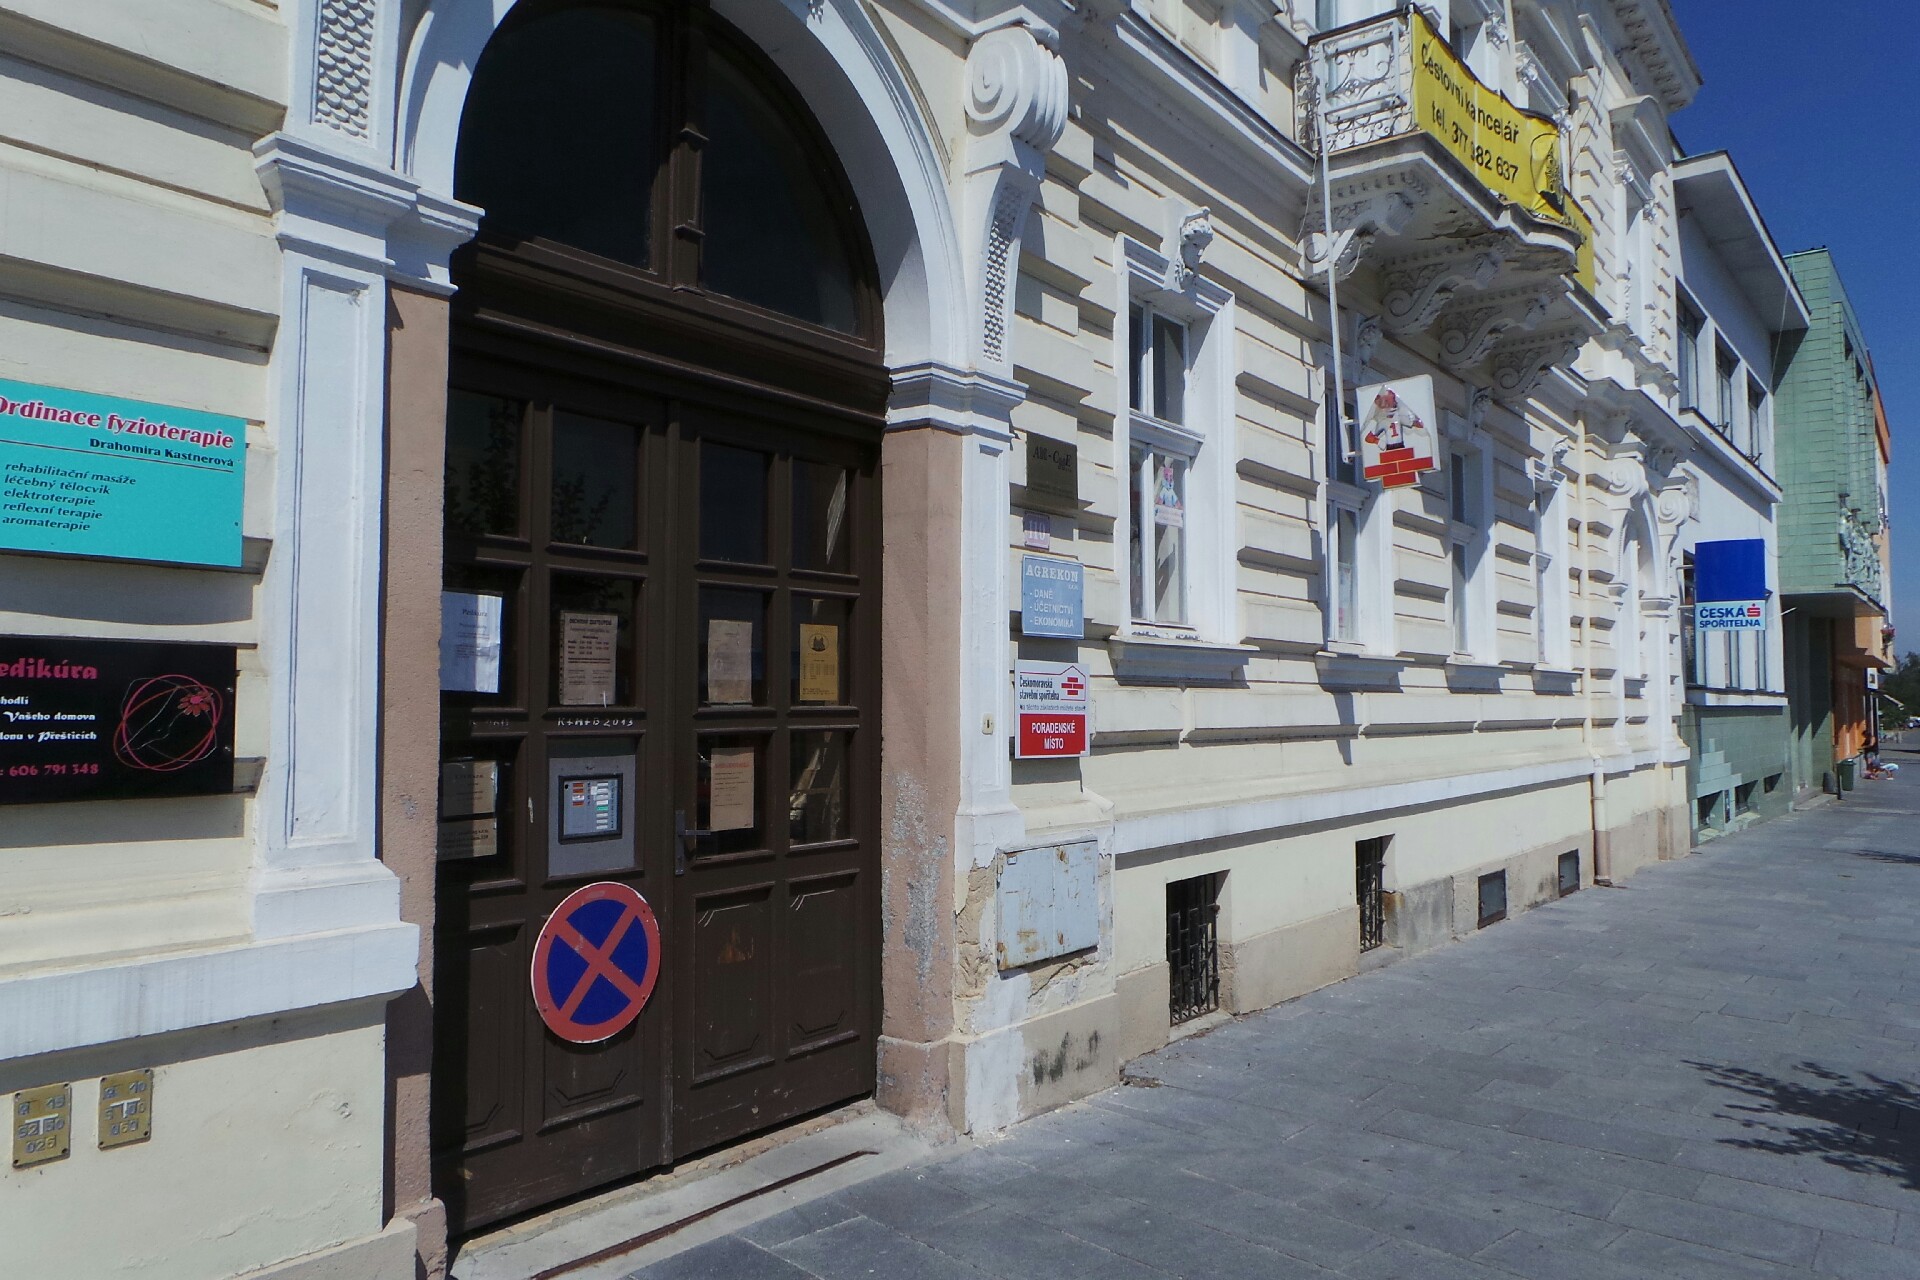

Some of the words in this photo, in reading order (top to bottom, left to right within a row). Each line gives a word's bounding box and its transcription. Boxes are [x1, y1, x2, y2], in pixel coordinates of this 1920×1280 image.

[1465, 91, 1519, 144] kancelář
[1432, 100, 1447, 134] tel.
[1452, 121, 1468, 153] 377
[1496, 156, 1518, 183] 637
[107, 414, 234, 448] fyzioterapie
[164, 448, 234, 467] Kastnerová
[5, 462, 89, 479] rehabilitační
[91, 473, 136, 485] masáže
[4, 474, 56, 490] léčebný
[60, 481, 110, 495] tělocvik
[4, 488, 96, 506] elektroterapie
[3, 502, 55, 514] reflexní
[57, 508, 102, 520] terapie
[2, 516, 90, 531] aromaterapie
[1026, 565, 1078, 582] AGREKON
[1700, 605, 1746, 618] ČESKÁ
[1034, 616, 1074, 627] EKONOMIKA
[1700, 618, 1761, 628] SPOŘITELNA
[3, 711, 50, 722] Vašeho
[54, 712, 96, 721] domova
[1031, 720, 1075, 733] PORADENSKÉ
[38, 731, 97, 742] Přešticích
[1044, 735, 1064, 749] MÍSTO
[9, 765, 38, 776] 606
[44, 764, 67, 775] 791
[72, 763, 98, 774] 348
